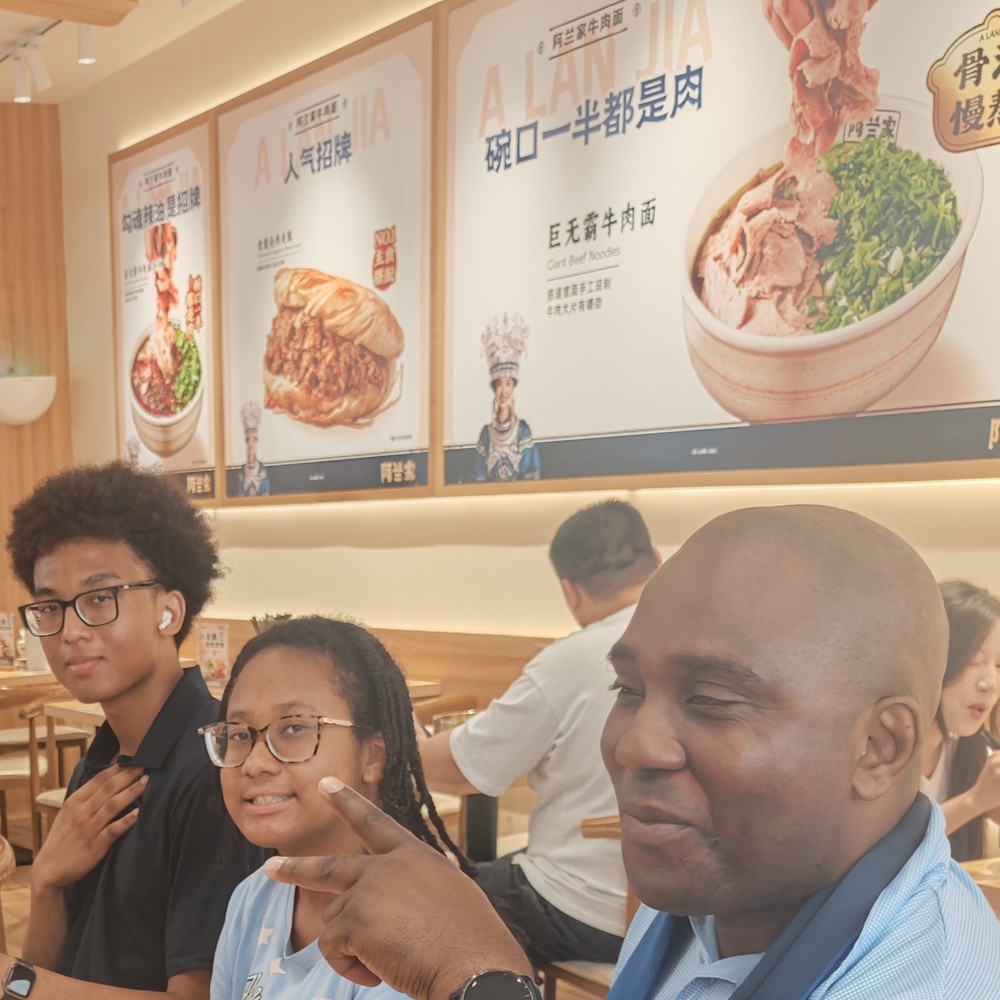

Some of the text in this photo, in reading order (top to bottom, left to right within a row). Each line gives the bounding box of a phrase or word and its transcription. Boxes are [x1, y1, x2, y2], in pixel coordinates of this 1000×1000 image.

[552, 7, 624, 51] 阿兰家牛肉面
[953, 45, 1000, 91] 骨
[484, 65, 704, 173] 碗口一半都是肉
[283, 131, 353, 184] 人气招牌
[549, 198, 656, 250] 巨无霸牛肉面
[380, 460, 416, 484] 阿兰家
